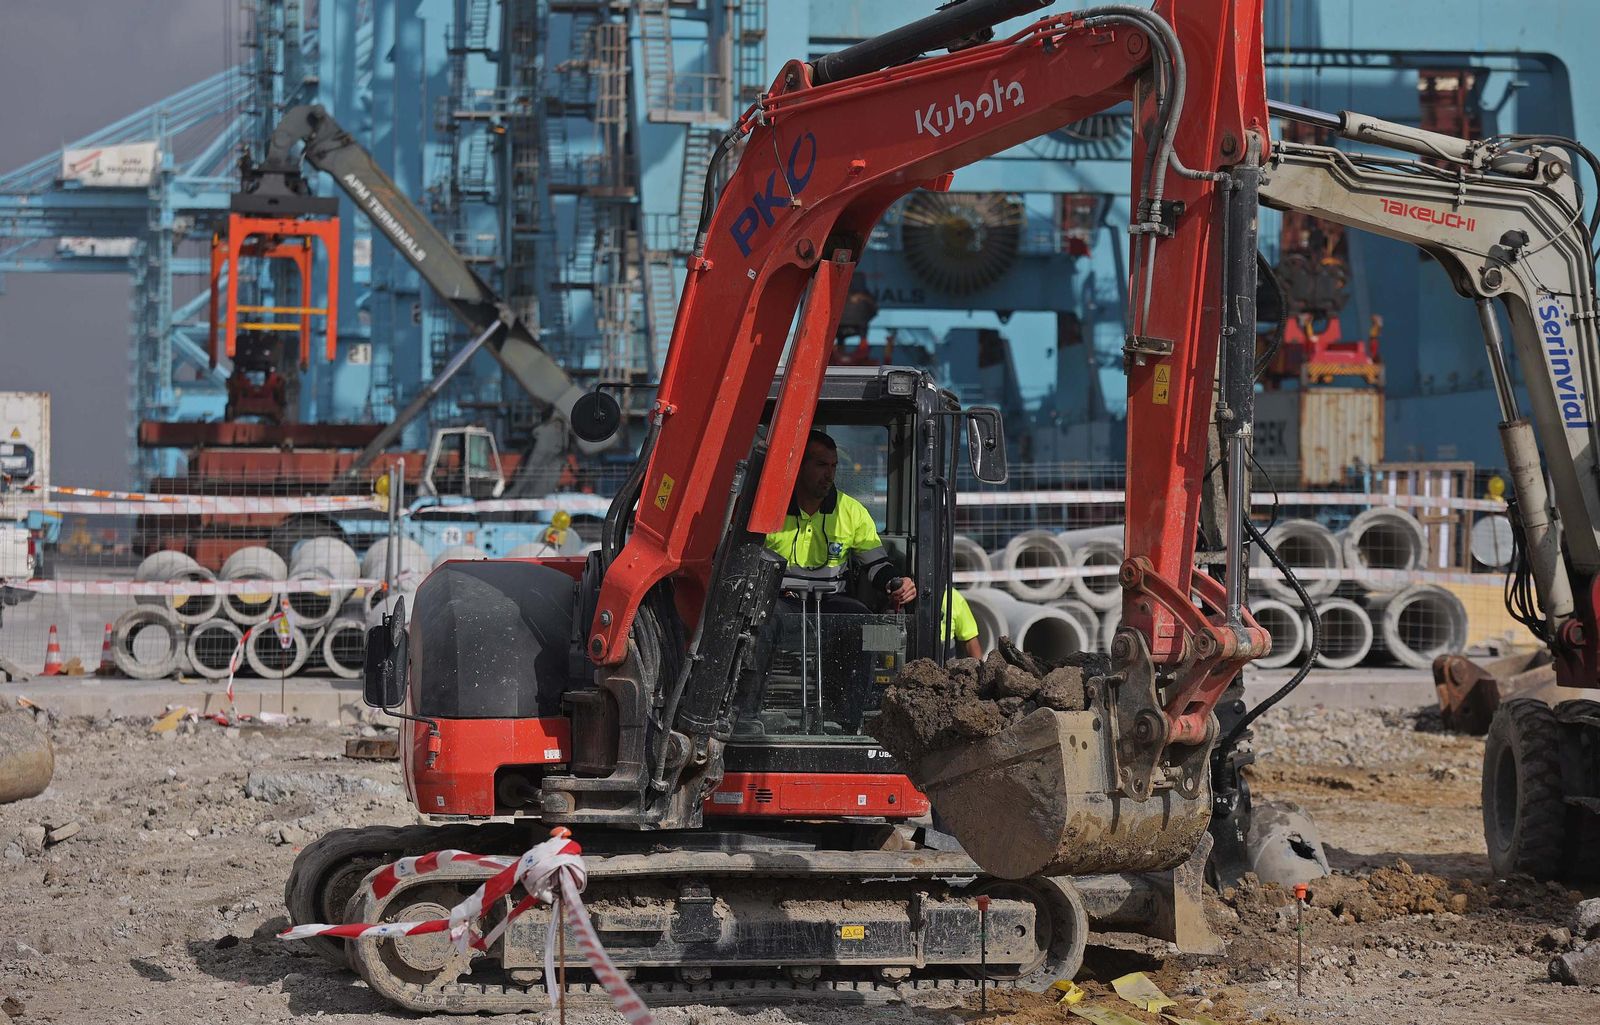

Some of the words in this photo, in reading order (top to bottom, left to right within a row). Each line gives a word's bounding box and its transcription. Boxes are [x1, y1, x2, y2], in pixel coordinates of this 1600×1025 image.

[914, 79, 1025, 137] Kubota
[343, 173, 371, 201] APM
[368, 195, 427, 262] TERMINALS
[729, 131, 817, 258] PKO
[1538, 304, 1593, 429] Serinvial
